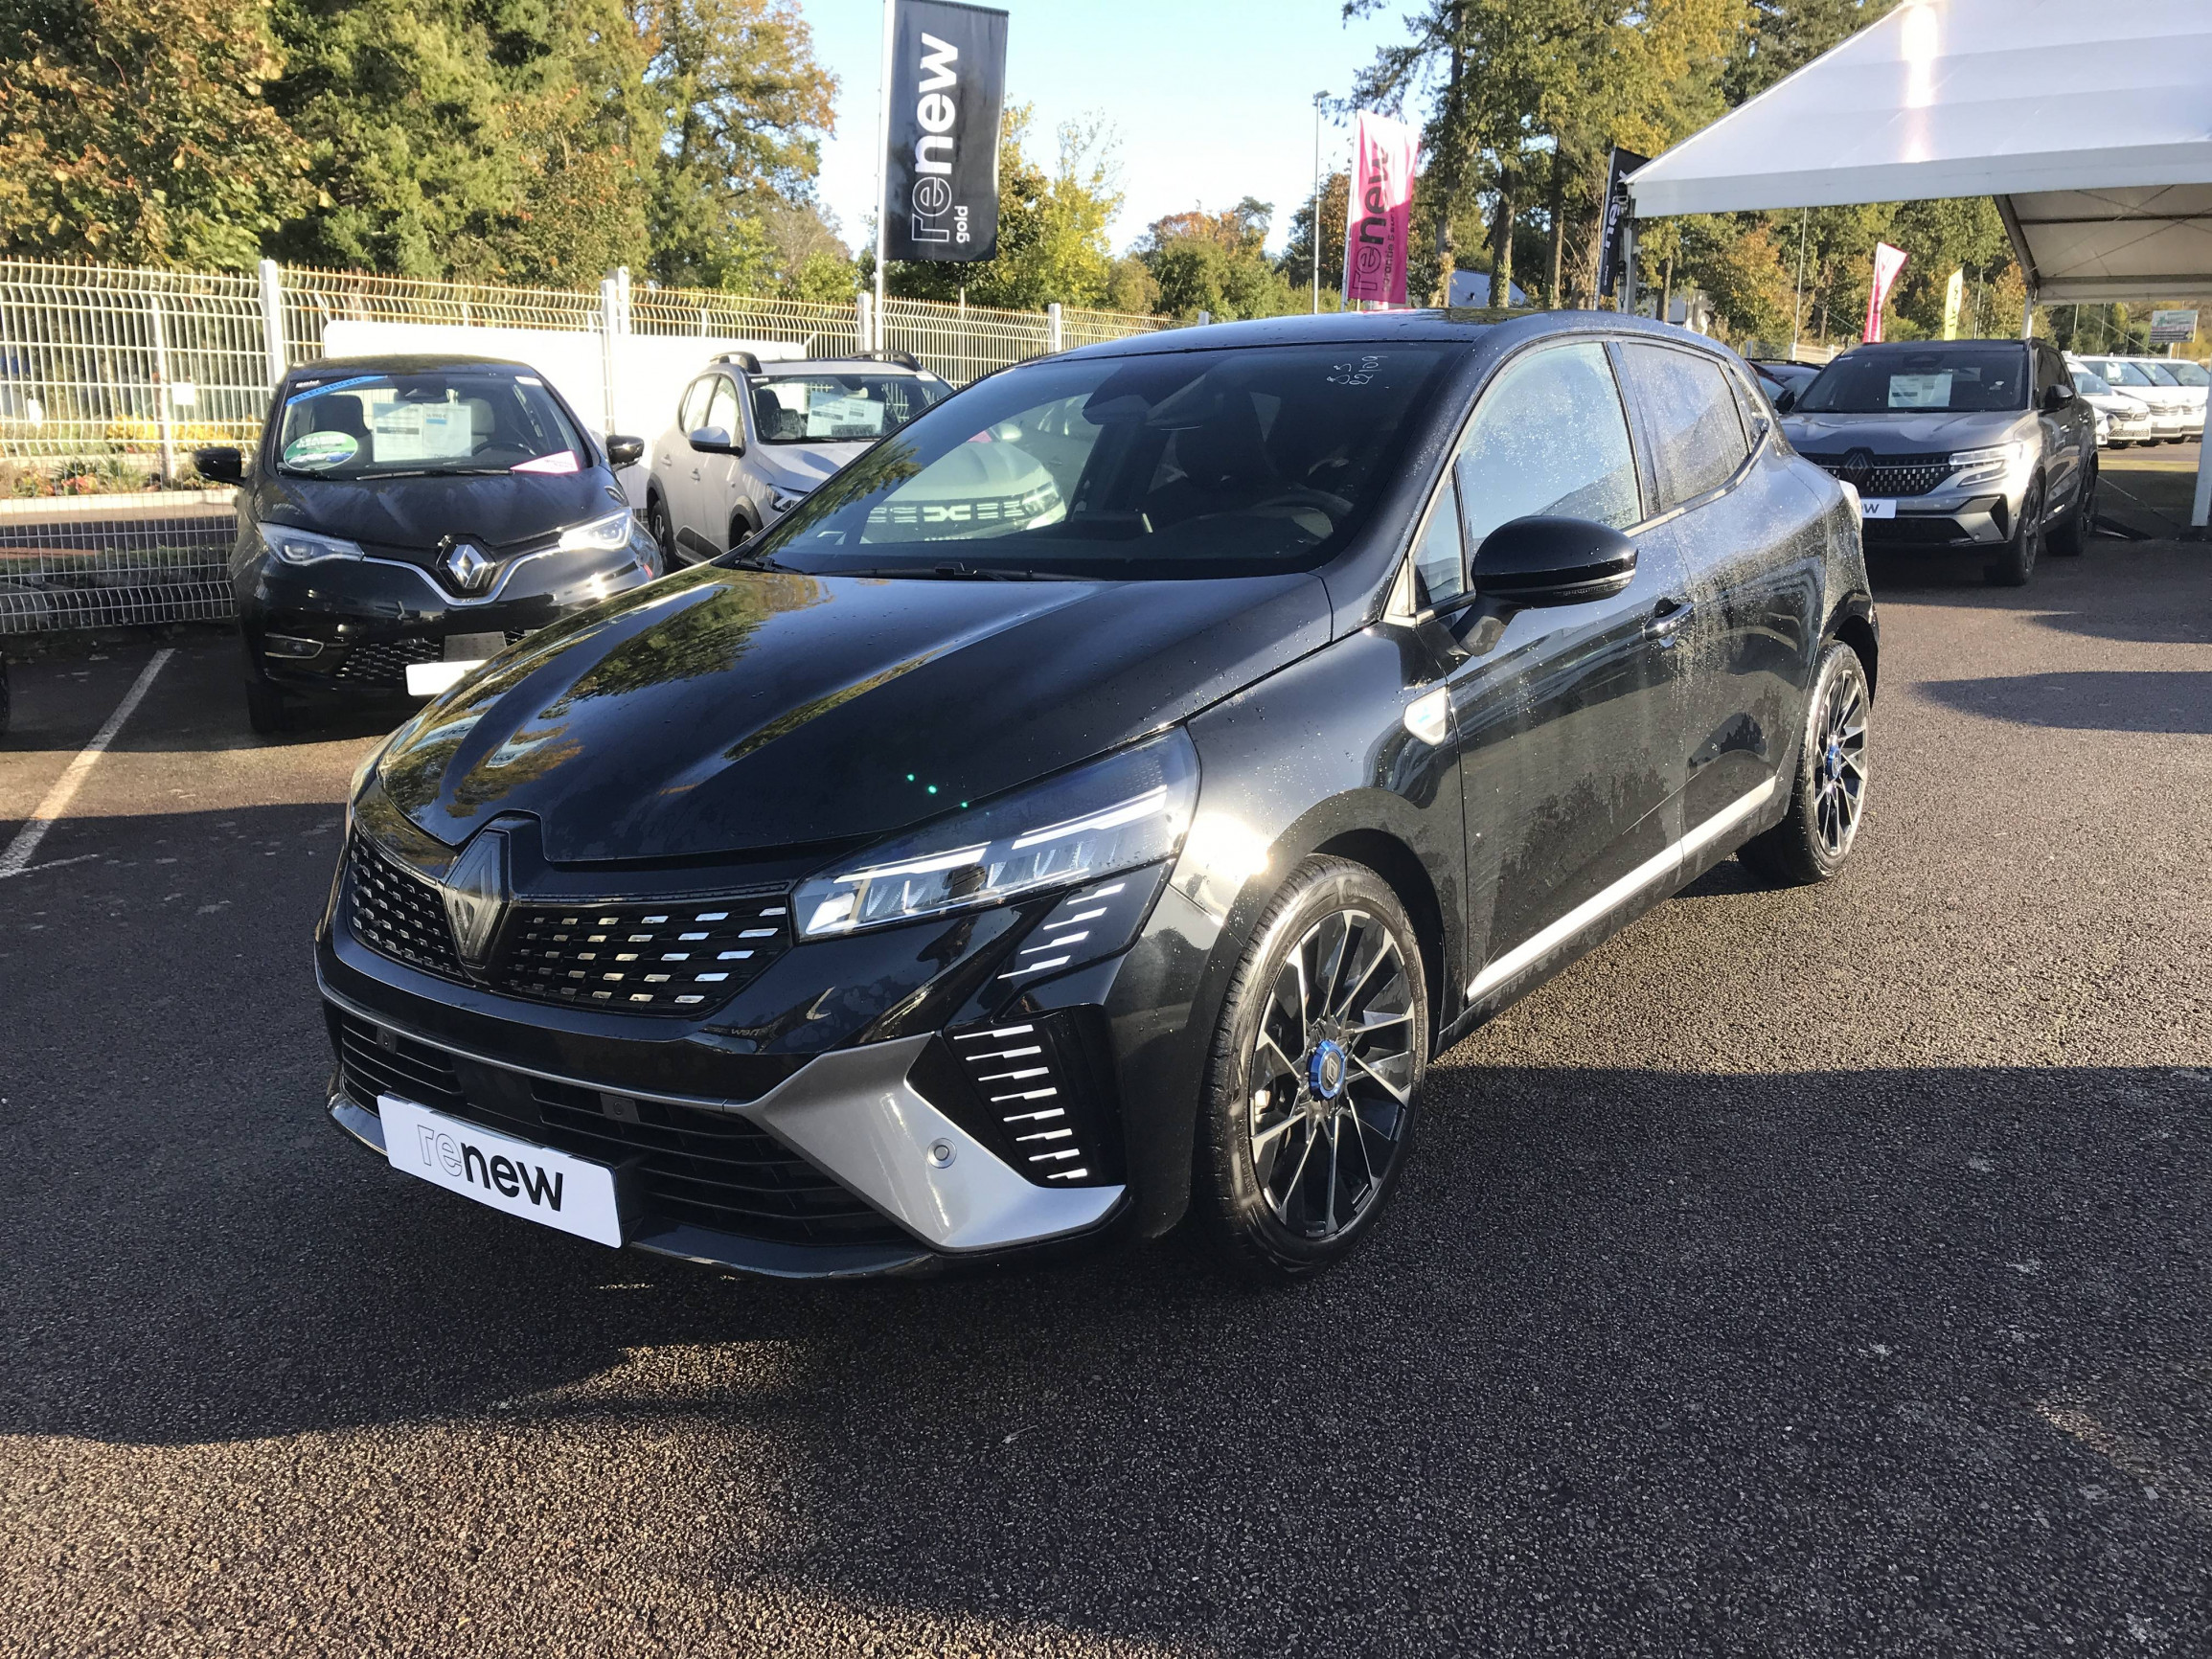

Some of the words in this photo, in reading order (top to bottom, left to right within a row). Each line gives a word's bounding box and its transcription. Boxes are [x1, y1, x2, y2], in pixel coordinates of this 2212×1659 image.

[911, 32, 958, 243] renew
[953, 205, 969, 244] gold
[417, 1124, 564, 1213] renew
